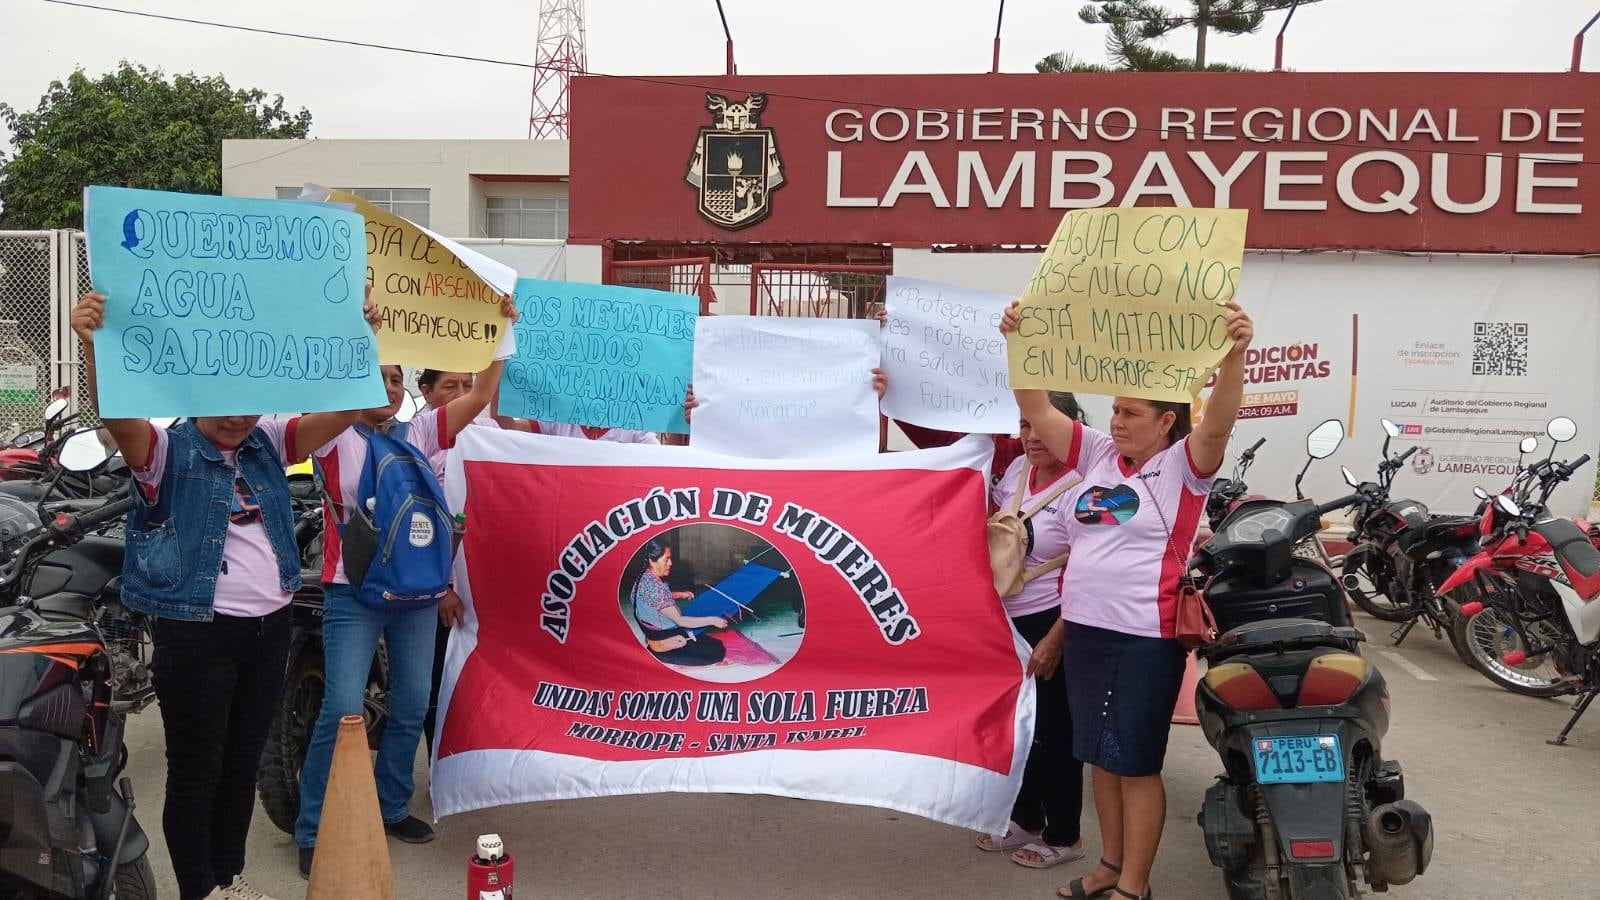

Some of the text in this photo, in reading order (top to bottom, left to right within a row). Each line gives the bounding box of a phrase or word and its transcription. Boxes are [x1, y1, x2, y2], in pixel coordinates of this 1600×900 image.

[825, 107, 1585, 143] GOBIERNO REGIONAL DE
[826, 150, 1584, 215] LAMBAYEQUE
[121, 209, 352, 260] QUEREMOS
[365, 221, 403, 257] STA
[411, 234, 440, 264] DE
[1054, 211, 1218, 258] AGUA CON
[131, 269, 255, 321] AGUA
[386, 273, 421, 297] CON
[1176, 259, 1241, 306] NOS
[377, 304, 498, 343] AMBAYEQUE!!
[571, 297, 697, 341] METALES
[1092, 308, 1228, 353] MATANDO
[121, 325, 371, 380] SALUDABLE
[513, 329, 643, 367] PESADOS
[889, 318, 1005, 361] es proteger
[1415, 341, 1445, 349] Enlace
[1023, 346, 1054, 378] EN
[507, 361, 688, 408] CONTAMINAN
[1246, 391, 1297, 404] DE MAYO
[522, 391, 557, 422] EL
[1237, 407, 1259, 418] ORA:
[1260, 406, 1272, 416] 09
[1430, 399, 1465, 407] Auditorio
[1478, 400, 1512, 408] Gobierno
[1514, 401, 1547, 410] Regional
[1441, 407, 1488, 416] Lambayeque
[1406, 425, 1421, 434] LIVE
[1425, 427, 1546, 438] @GobiernoRegionalLambayeque
[1437, 463, 1522, 476] LAMBAYEQUE
[1439, 455, 1520, 465] GOBIERNO REGIONA
[540, 486, 921, 646] ASOCIACIÓN DE MUJERES
[533, 681, 930, 724] UNIDAS SOMOS UNA SOLA FUERZA
[566, 721, 685, 753] MORROPE
[705, 732, 776, 753] SANTA
[1279, 739, 1312, 750] PERU
[1259, 749, 1337, 774] 7113-EB
